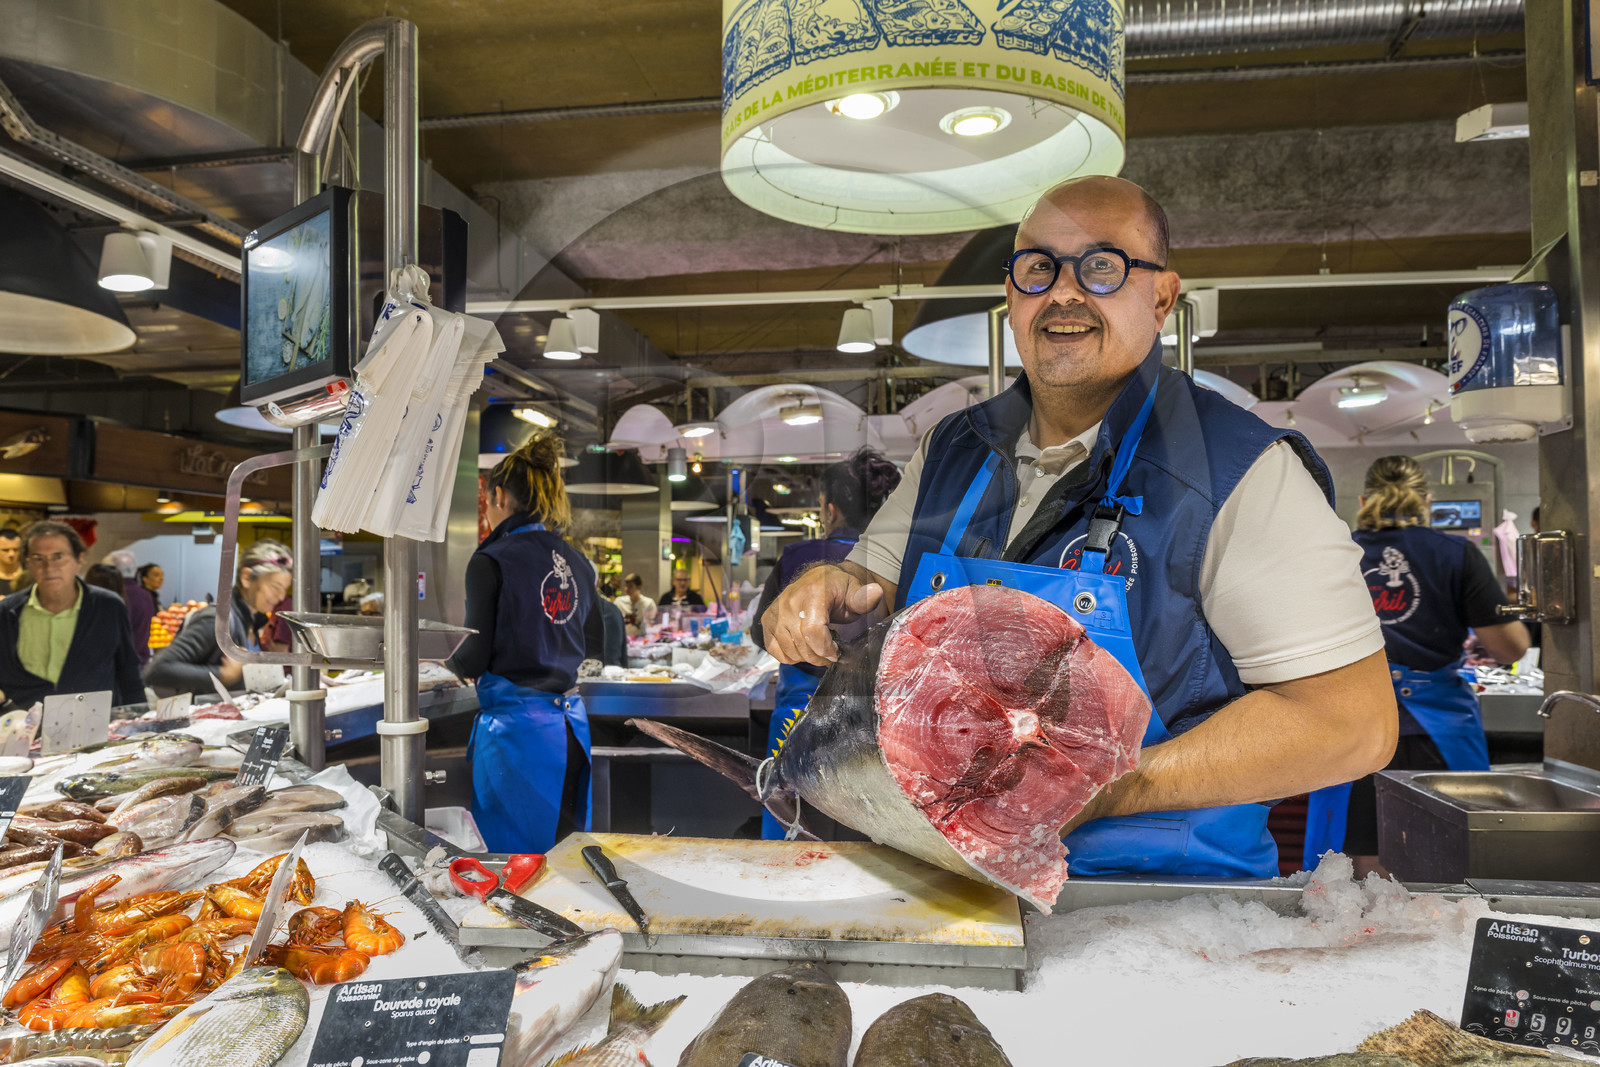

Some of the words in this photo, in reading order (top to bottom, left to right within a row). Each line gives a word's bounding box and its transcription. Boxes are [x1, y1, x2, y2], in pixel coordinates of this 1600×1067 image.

[744, 100, 759, 121] DE
[762, 91, 783, 111] LA
[787, 56, 957, 100] MÉDITERRANÉE
[962, 62, 990, 78] ET
[996, 65, 1026, 82] DU
[1031, 70, 1089, 101] BASSIN
[1091, 90, 1106, 111] DE
[1126, 538, 1139, 575] POISSONS
[1489, 921, 1539, 938] Artisan
[1487, 930, 1538, 944] Poissonnier
[1561, 947, 1600, 962] Turbo
[1534, 955, 1587, 969] Scophthalmus
[338, 983, 382, 996] Artisan
[335, 993, 380, 1003] Poissonnier
[373, 996, 422, 1012] Daurade
[425, 992, 461, 1010] royale
[1532, 994, 1561, 1003] Sous-zone
[390, 1009, 414, 1019] Sparus
[414, 1008, 438, 1017] aurata
[406, 1040, 417, 1048] Type
[417, 1039, 436, 1047] d'engin
[444, 1037, 460, 1045] pêche
[399, 1055, 415, 1064] pêche
